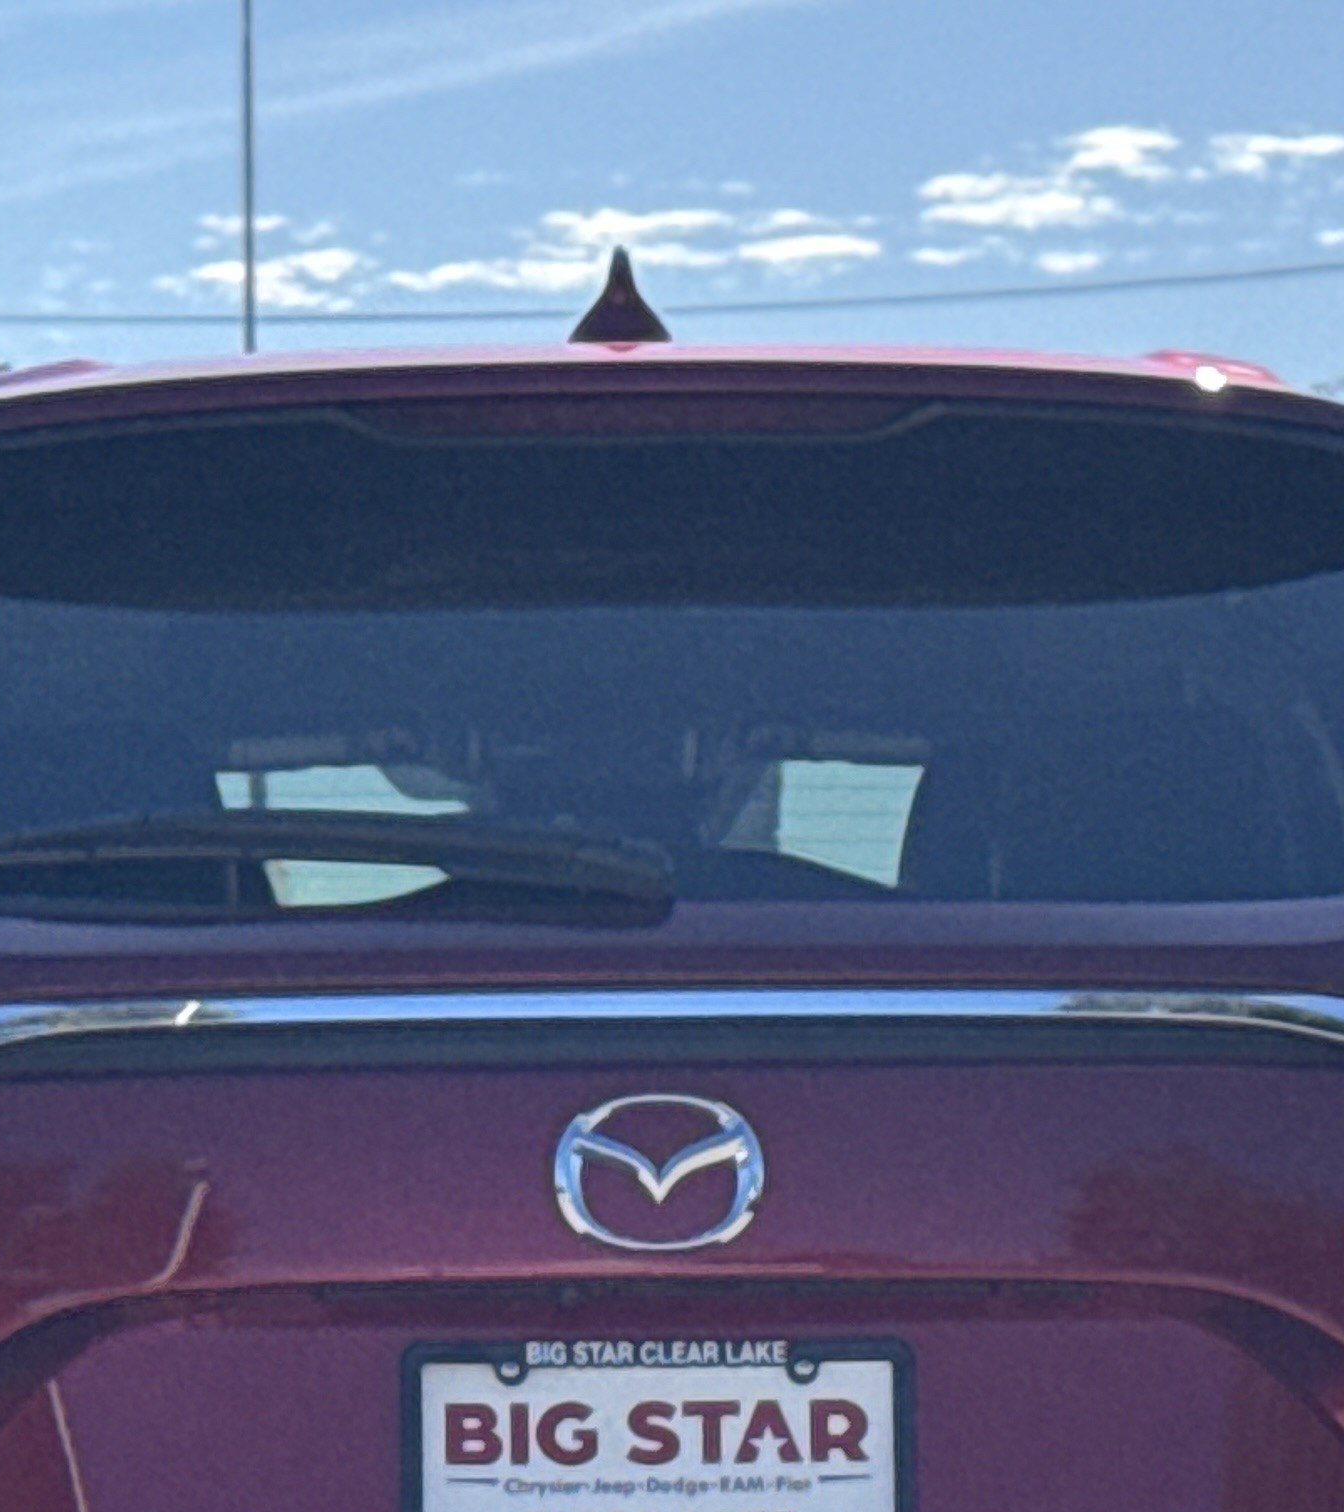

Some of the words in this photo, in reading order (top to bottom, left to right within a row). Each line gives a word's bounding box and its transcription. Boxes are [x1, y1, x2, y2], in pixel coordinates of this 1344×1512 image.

[526, 1341, 567, 1365] BIG
[573, 1341, 634, 1364] STAR
[640, 1341, 719, 1364] CLEAR
[725, 1340, 788, 1364] LAKE
[445, 1402, 599, 1466] BIG
[627, 1400, 869, 1465] STAR
